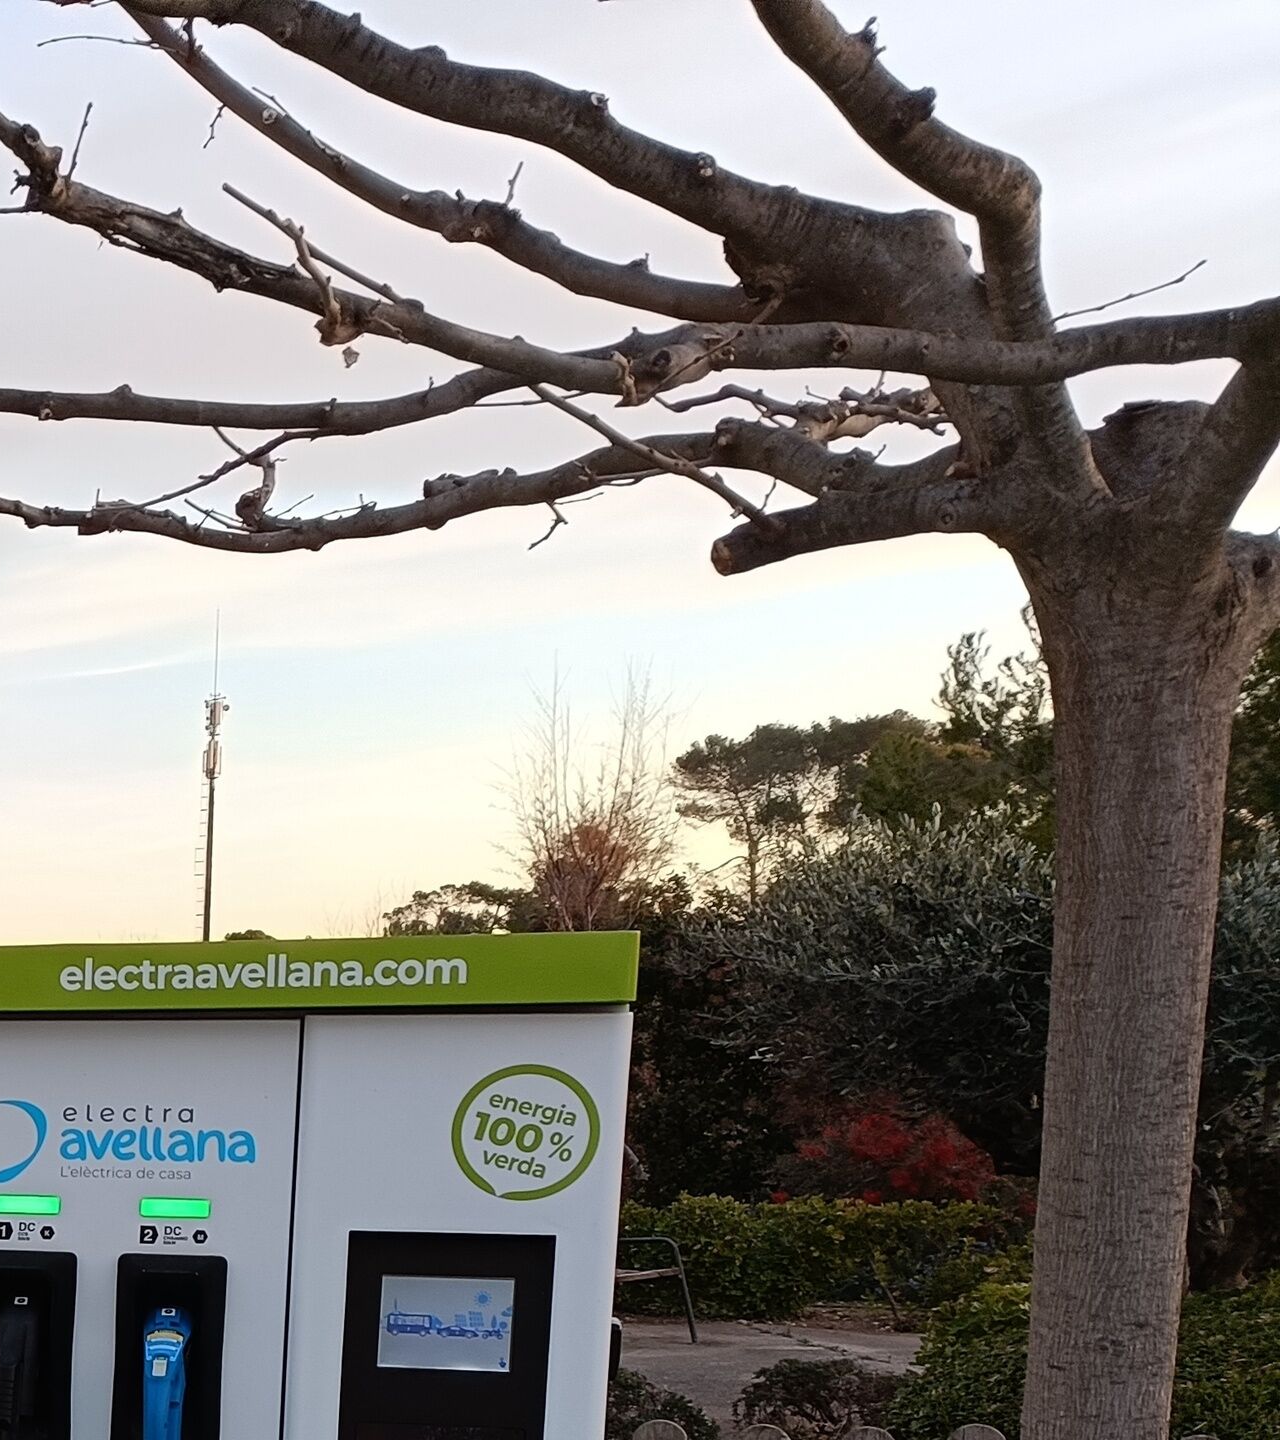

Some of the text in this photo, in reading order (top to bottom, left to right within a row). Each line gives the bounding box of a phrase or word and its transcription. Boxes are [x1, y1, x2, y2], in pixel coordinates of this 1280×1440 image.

[59, 954, 468, 992] electraavellana.com
[62, 1104, 194, 1123] electra
[489, 1094, 577, 1126] energia
[60, 1125, 255, 1163] avellana
[474, 1112, 574, 1162] 100 %
[60, 1166, 191, 1180] L'elèctrica de casa
[483, 1150, 546, 1179] verda
[18, 1222, 36, 1232] DC
[164, 1226, 182, 1236] DC
